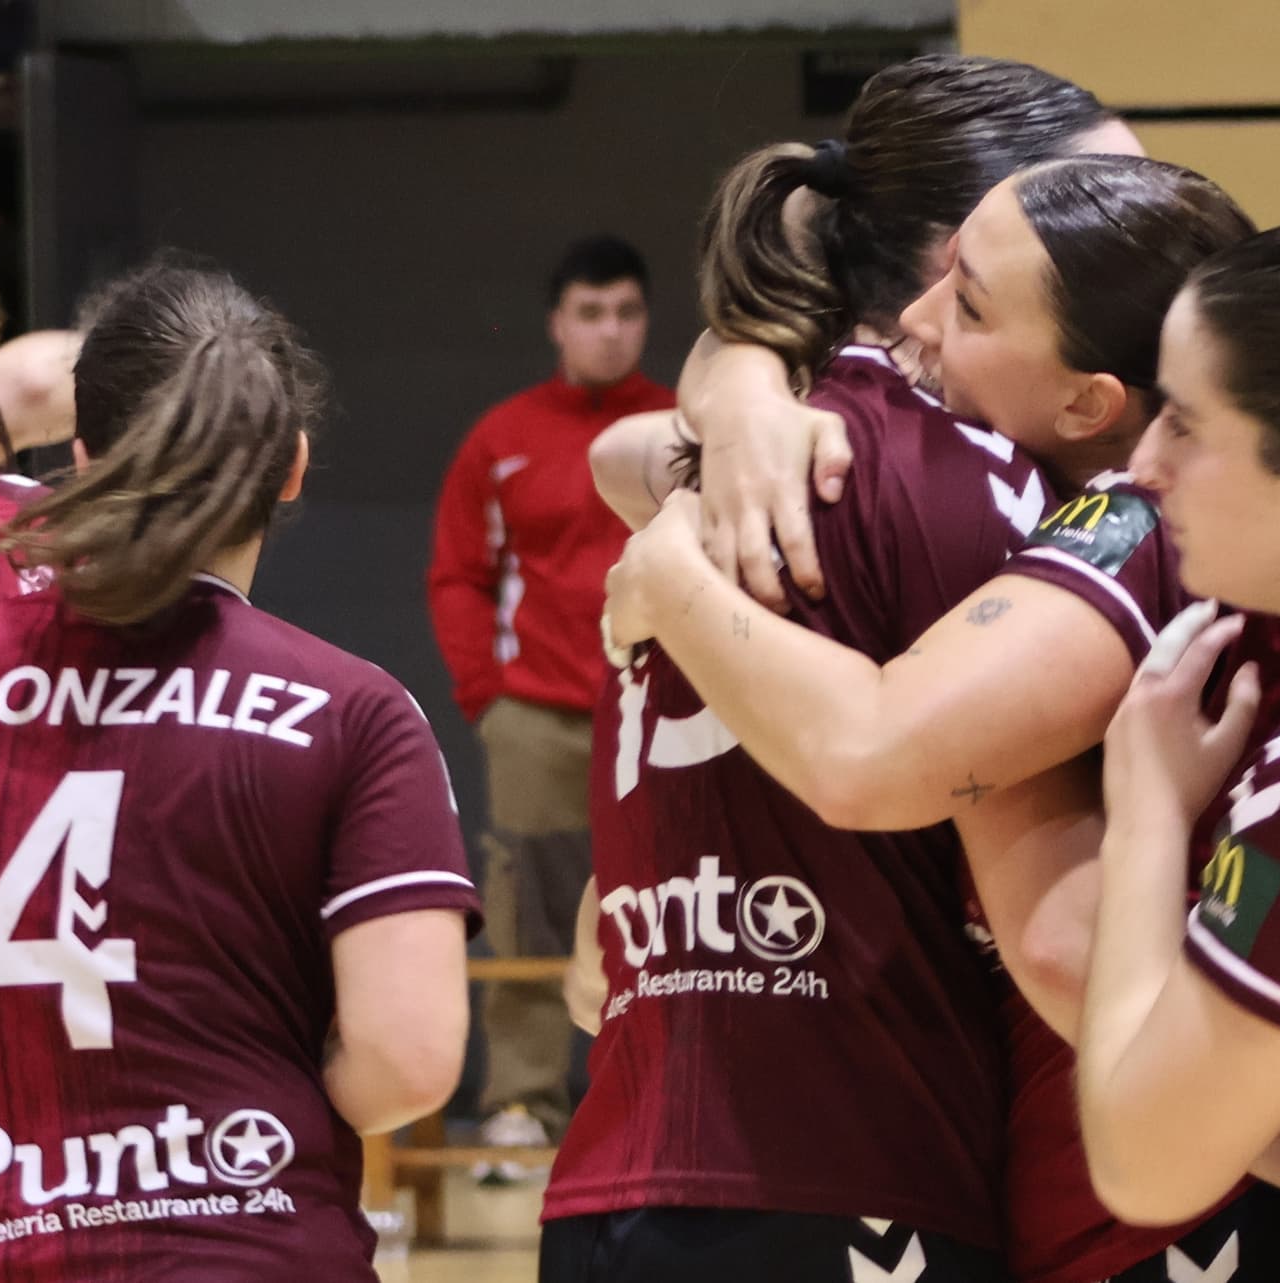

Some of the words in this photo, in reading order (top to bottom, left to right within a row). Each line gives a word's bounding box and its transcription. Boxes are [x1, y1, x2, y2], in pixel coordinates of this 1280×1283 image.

[773, 965, 829, 999] 24h
[65, 1192, 240, 1231] Restaurante
[243, 1187, 297, 1214] 24h
